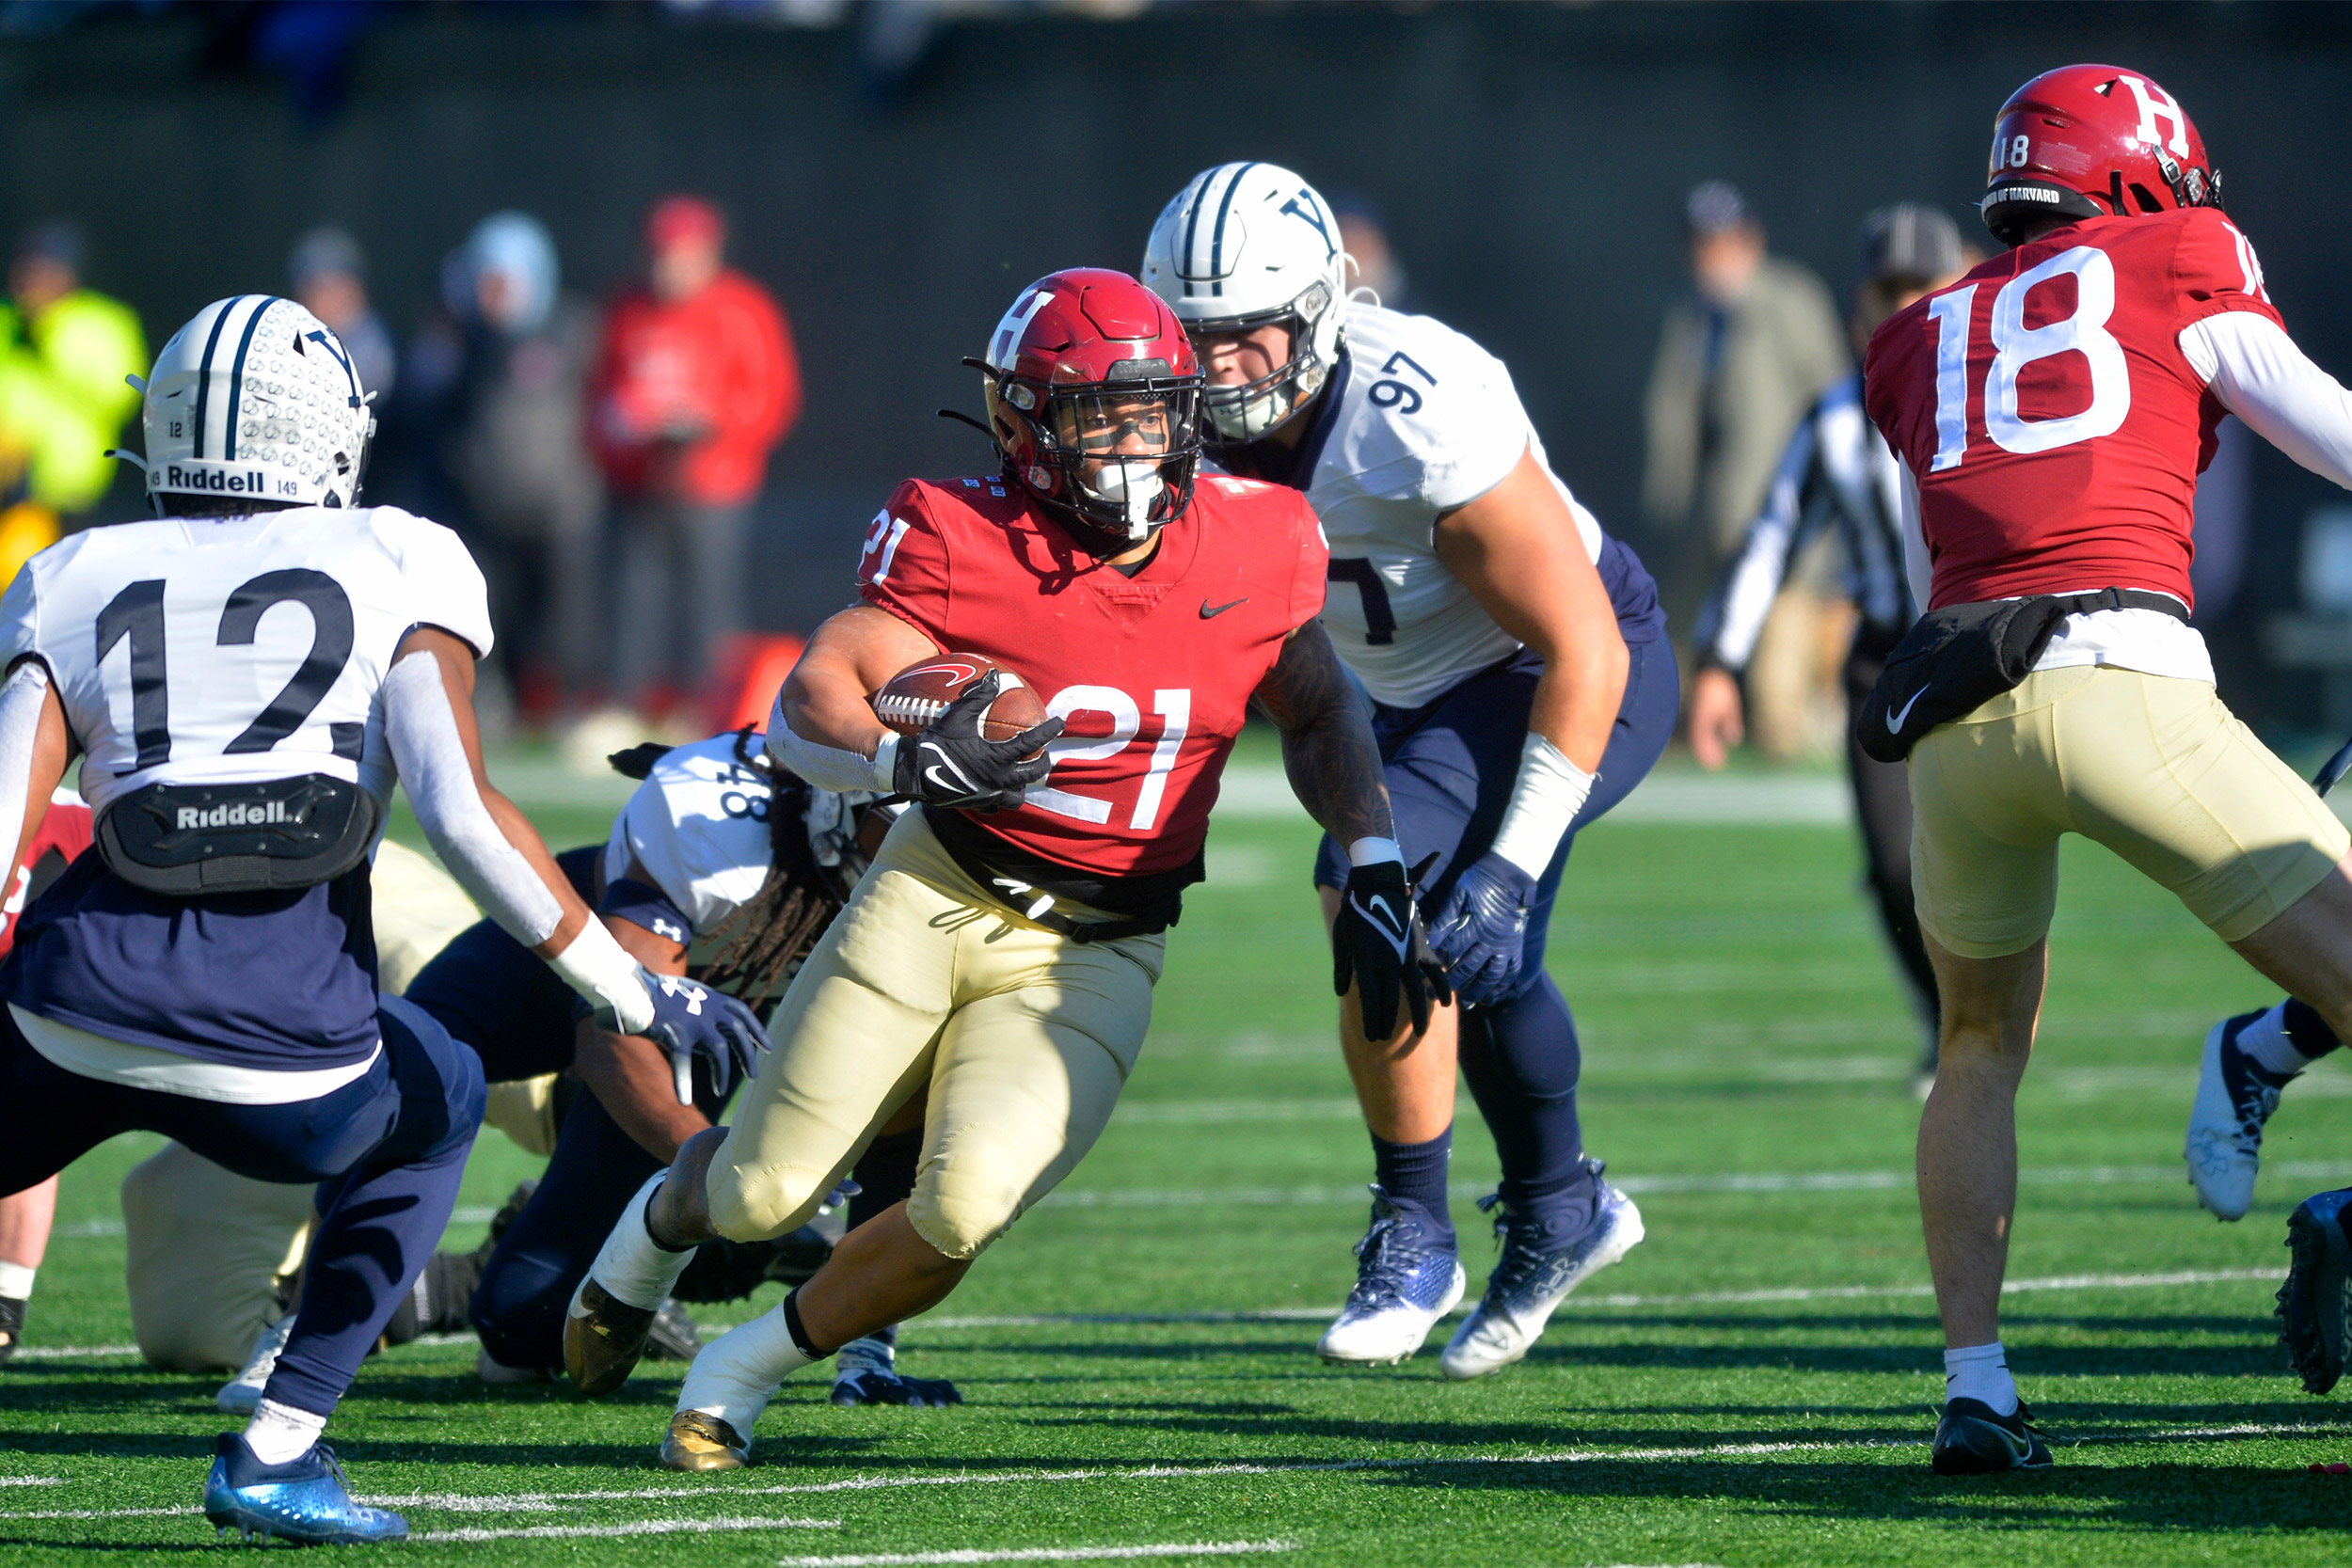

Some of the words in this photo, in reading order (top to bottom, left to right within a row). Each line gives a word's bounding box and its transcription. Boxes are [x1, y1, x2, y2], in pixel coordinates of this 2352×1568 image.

[2000, 135, 2029, 169] 18
[2119, 75, 2189, 160] H
[1279, 188, 1338, 267] Y
[2010, 187, 2060, 203] HARVARD
[991, 289, 1056, 372] H
[1927, 245, 2131, 472] 18
[1368, 350, 1438, 415] 97
[169, 421, 182, 438] 12
[168, 466, 263, 493] Riddell
[278, 479, 297, 496] 149
[855, 509, 911, 587] 21
[96, 567, 364, 778] 12
[1025, 684, 1191, 830] 21
[177, 800, 285, 830] Riddell
